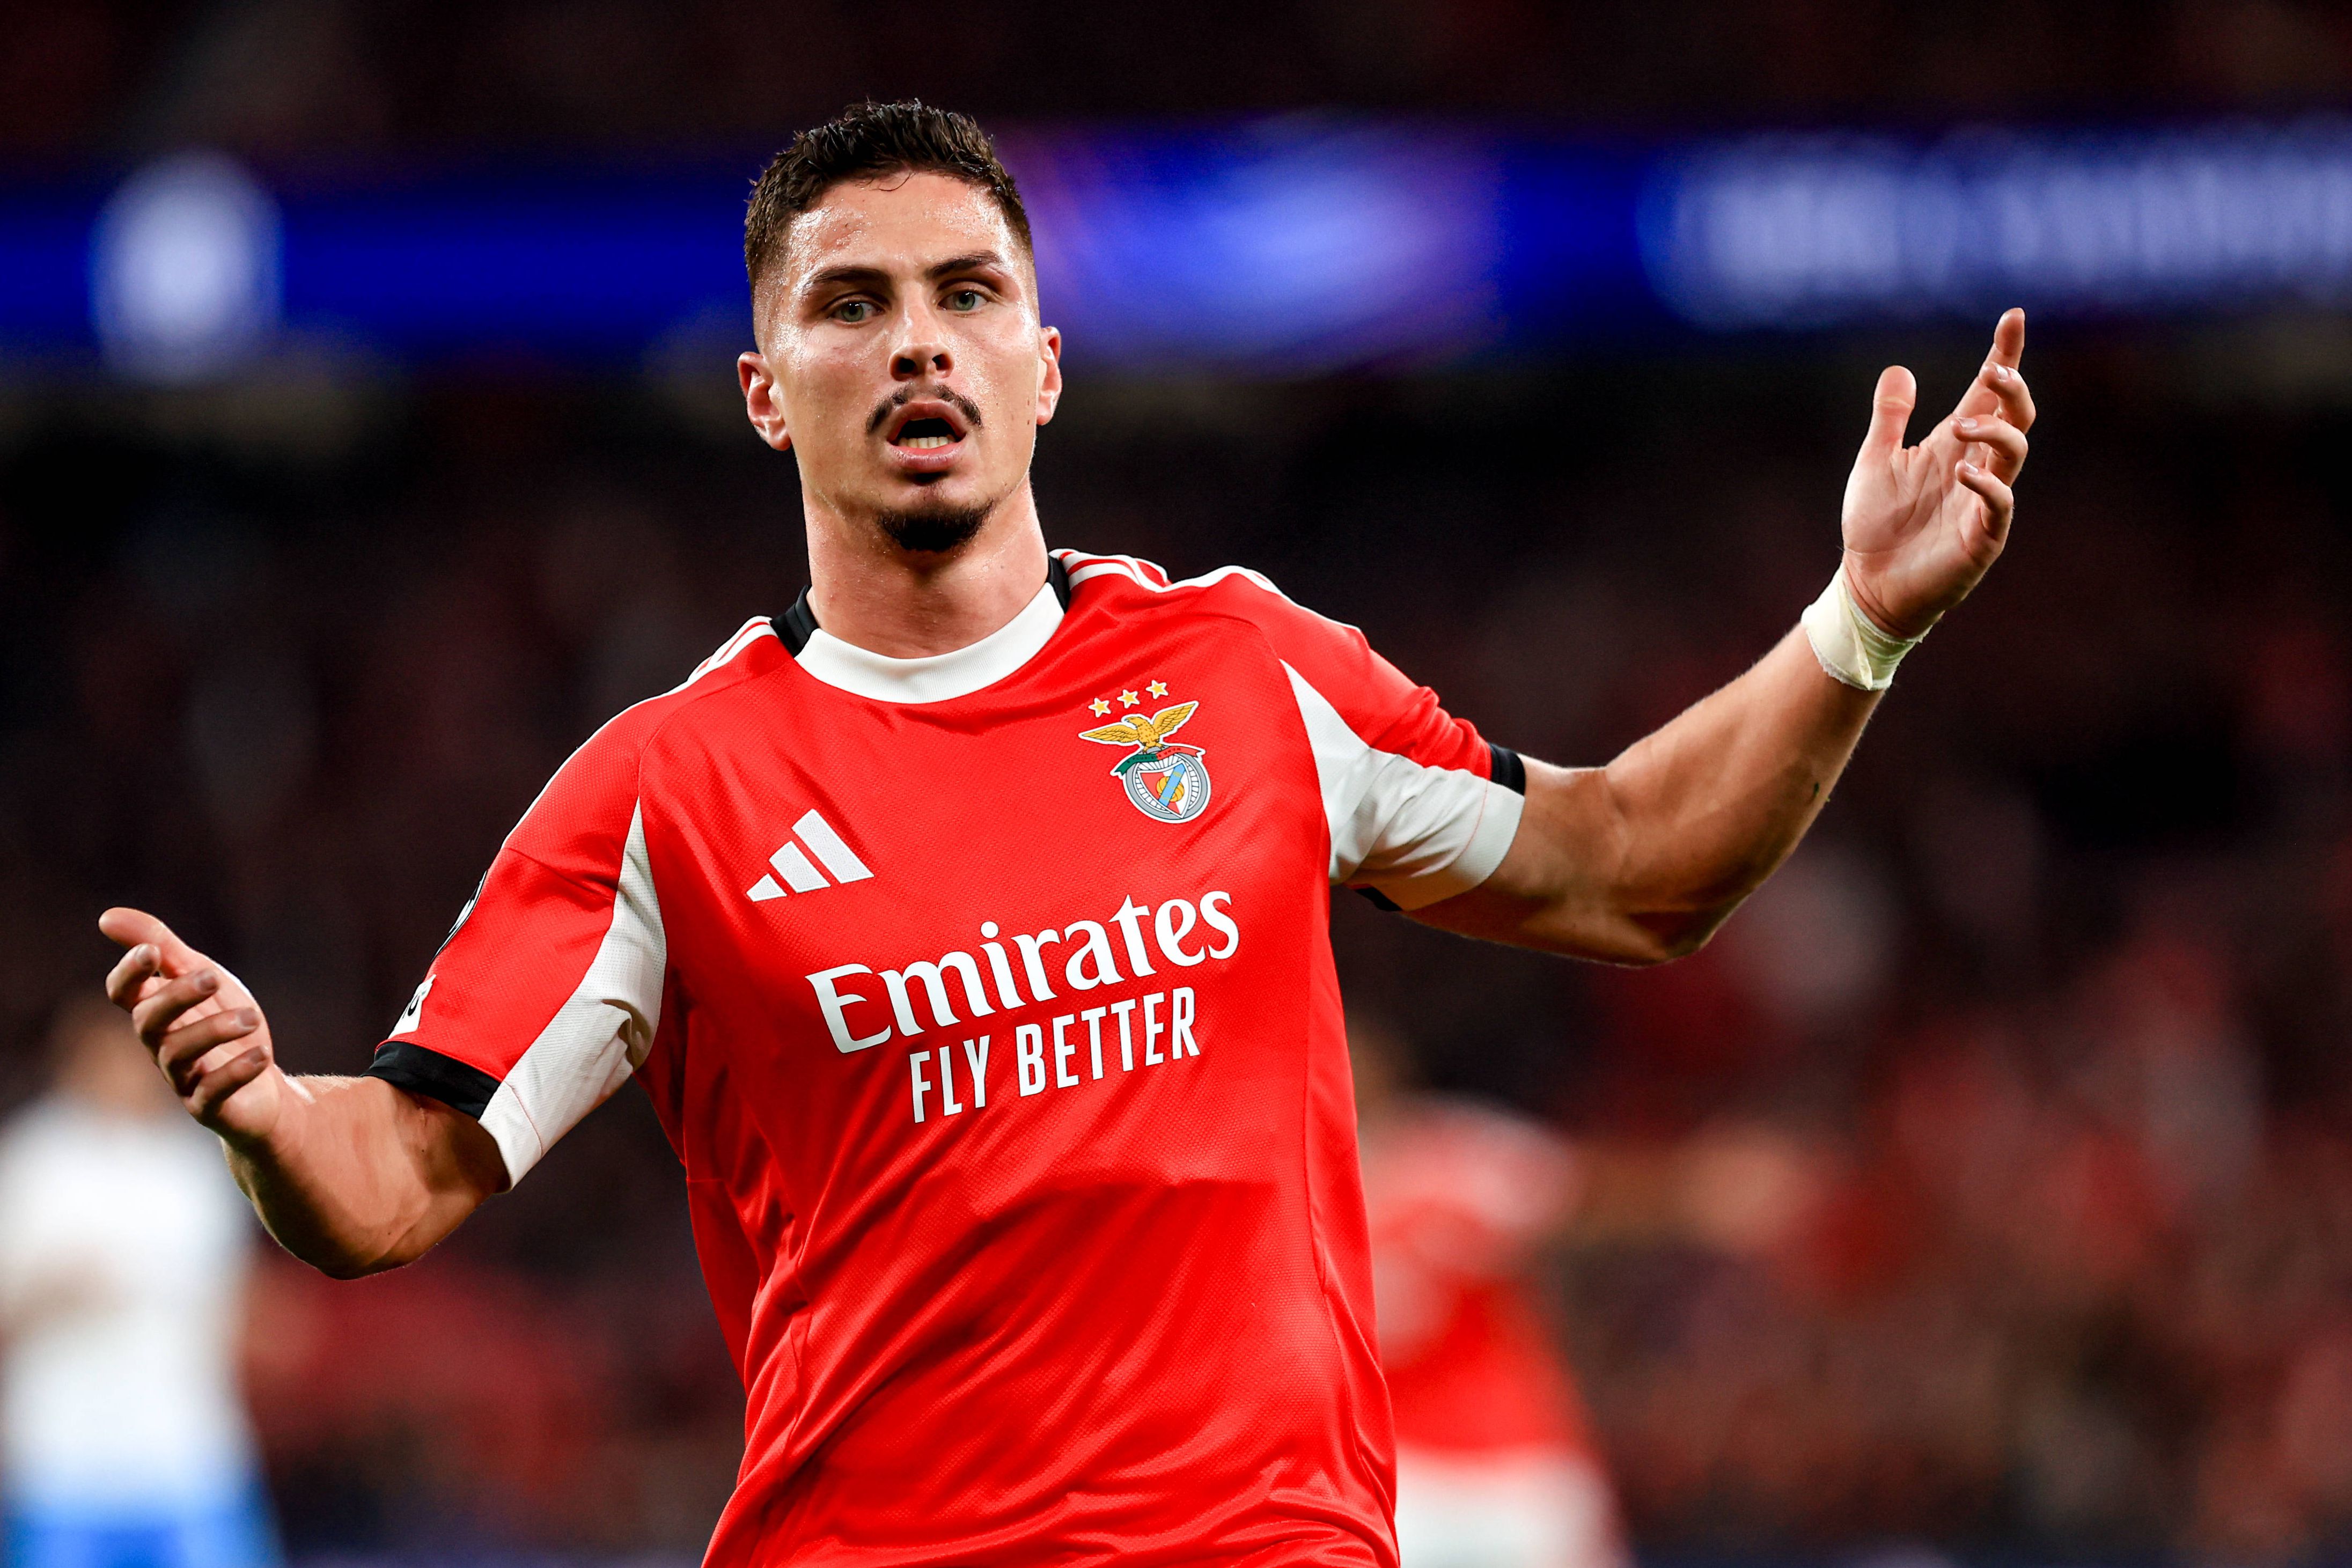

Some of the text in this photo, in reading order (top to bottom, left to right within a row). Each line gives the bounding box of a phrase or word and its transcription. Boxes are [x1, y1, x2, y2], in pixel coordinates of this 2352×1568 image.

[804, 890, 1239, 1054] Emirates
[909, 986, 1201, 1123] FLY BETTER
